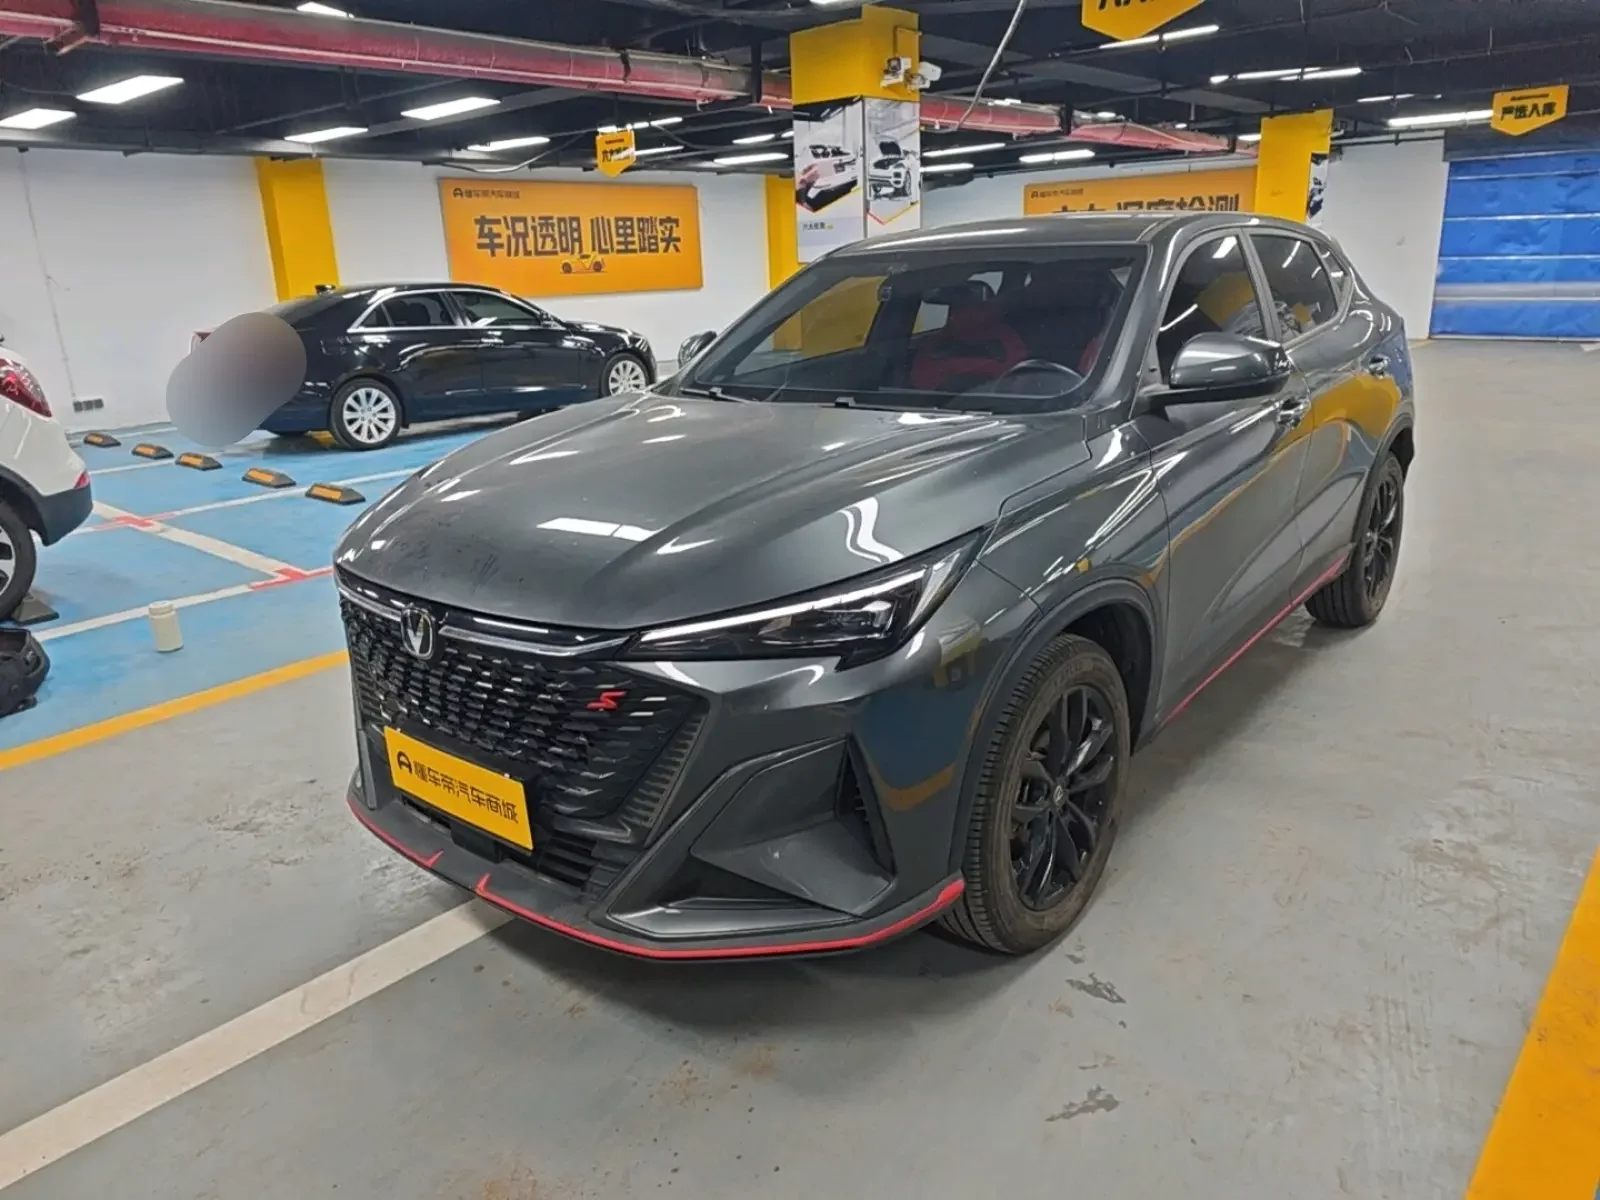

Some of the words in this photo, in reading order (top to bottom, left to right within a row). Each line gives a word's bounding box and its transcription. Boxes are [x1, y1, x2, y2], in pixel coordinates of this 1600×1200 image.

[474, 214, 583, 258] 车况透明
[589, 214, 681, 255] 心里踏实
[414, 760, 519, 824] 懂车帝汽车商城
